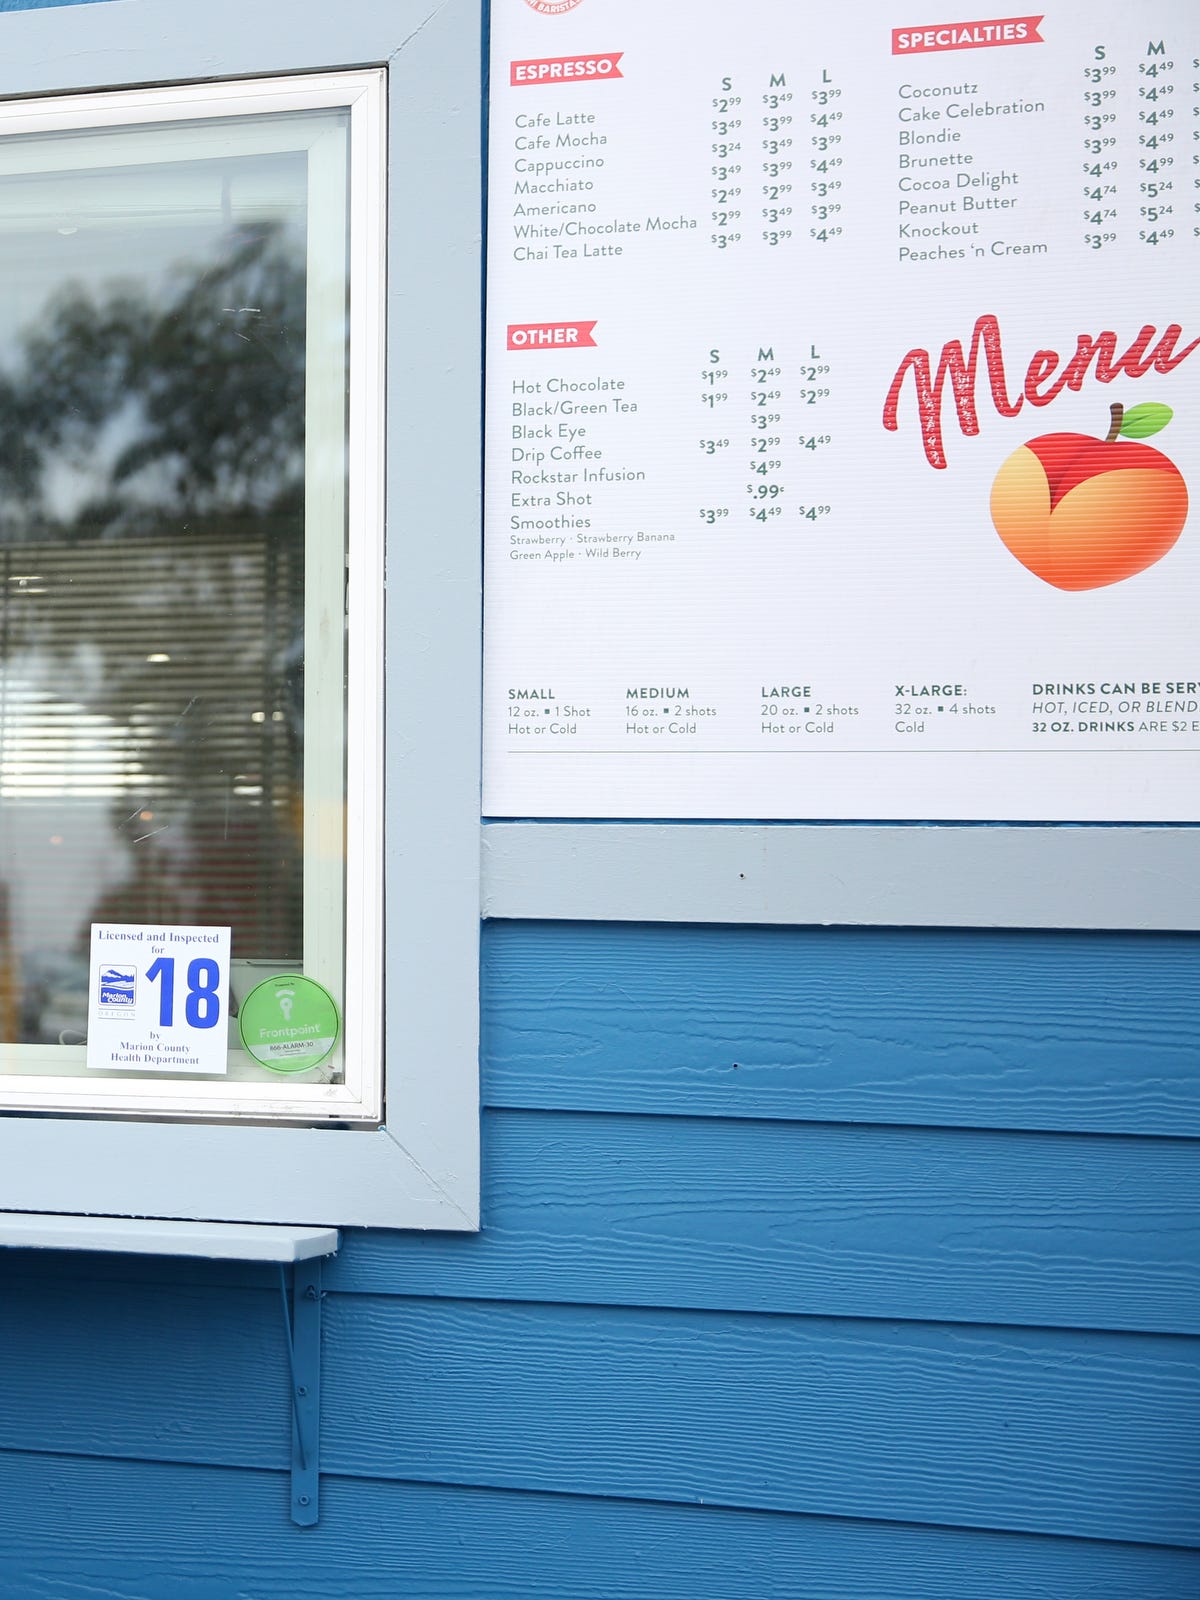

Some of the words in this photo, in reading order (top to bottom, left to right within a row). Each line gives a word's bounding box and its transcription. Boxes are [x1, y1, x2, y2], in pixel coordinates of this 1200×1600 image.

[898, 22, 1028, 49] SPECIALTIES
[1095, 46, 1105, 60] S
[1147, 40, 1165, 55] M
[516, 58, 613, 81] ESPRESSO
[722, 78, 731, 91] S
[770, 73, 785, 87] M
[823, 70, 832, 83] L
[899, 83, 977, 98] Coconutz
[899, 107, 940, 122] Cake
[946, 100, 1045, 119] Celebration
[515, 113, 550, 128] Cafe
[557, 112, 595, 125] Latte
[515, 135, 550, 150] Cafe
[556, 132, 606, 147] Mocha
[900, 128, 960, 145] Blondie
[515, 155, 604, 176] Cappuccino
[900, 154, 973, 168] Brunette
[515, 179, 593, 194] Macchiato
[899, 177, 949, 191] Cocoa
[957, 171, 1018, 191] Delight
[514, 201, 596, 216] Americano
[900, 201, 956, 215] Peanut
[964, 196, 1017, 210] Butter
[514, 220, 640, 238] White/Chocolate
[646, 216, 696, 230] Mocha
[900, 222, 978, 238] Knockout
[513, 246, 549, 262] Chai
[553, 245, 577, 258] Tea
[584, 244, 622, 257] Latte
[900, 245, 965, 261] Peaches
[991, 241, 1047, 255] Cream
[512, 328, 578, 345] OTHER
[710, 350, 719, 363] S
[758, 348, 774, 361] M
[811, 345, 820, 359] L
[513, 380, 541, 394] Hot
[547, 377, 624, 392] Chocolate
[882, 314, 1200, 470] Menu
[513, 401, 607, 416] Black/Green
[613, 399, 637, 412] Tea
[513, 425, 552, 439] Black
[559, 424, 586, 442] Eye
[512, 448, 544, 466] Drip
[551, 446, 602, 460] Coffee
[512, 470, 578, 484] Rockstar
[584, 467, 645, 481] Infusion
[512, 493, 550, 506] Extra
[557, 492, 591, 505] Shot
[511, 515, 590, 529] Smoothies
[510, 535, 566, 546] Strawberry
[577, 533, 633, 545] Strawberry
[637, 532, 675, 541] Banana
[510, 550, 541, 559] Green
[545, 550, 574, 562] Apple
[586, 548, 608, 557] Wild
[613, 548, 641, 560] Berry
[509, 689, 555, 699] SMALL
[627, 688, 689, 698] MEDIUM
[762, 687, 810, 697] LARGE
[896, 685, 966, 696] X-LARGE:
[1033, 684, 1095, 695] DRINKS
[1101, 683, 1135, 694] CAN
[1142, 683, 1160, 694] BE
[508, 706, 520, 717] 12
[555, 706, 560, 717] 1
[564, 706, 590, 716] Shot
[626, 705, 638, 716] 16
[642, 707, 658, 717] oz.
[675, 705, 681, 716] 2
[686, 705, 716, 716] shots
[761, 705, 777, 715] 20
[816, 704, 822, 715] 2
[827, 704, 859, 715] shots
[895, 704, 910, 714] 32
[914, 705, 933, 715] oz.
[949, 704, 958, 714] 4
[963, 703, 995, 714] shots
[1033, 702, 1067, 715] HOT,
[1073, 702, 1112, 714] ICED,
[1119, 701, 1140, 712] OR
[1146, 700, 1200, 713] BLEND
[509, 724, 530, 734] Hot
[550, 723, 576, 734] Cold
[627, 723, 648, 733] Hot
[652, 725, 665, 734] or
[669, 722, 696, 733] Cold
[762, 722, 784, 733] Hot
[805, 722, 833, 733] Cold
[895, 721, 924, 732] Cold
[1033, 723, 1046, 732] 32
[1051, 722, 1073, 732] OZ.
[1079, 722, 1134, 731] DRINKS
[1139, 721, 1167, 731] ARE
[1172, 721, 1187, 732] $2
[99, 931, 143, 940] Licensed
[146, 932, 167, 942] and
[170, 933, 218, 944] Inspected
[151, 945, 165, 954] for
[145, 956, 220, 1029] 18
[149, 1031, 160, 1041] by
[260, 1024, 320, 1038] Frontpoint
[121, 1042, 153, 1051] Marion
[157, 1044, 189, 1052] County
[112, 1053, 140, 1062] Health
[143, 1053, 199, 1066] Department
